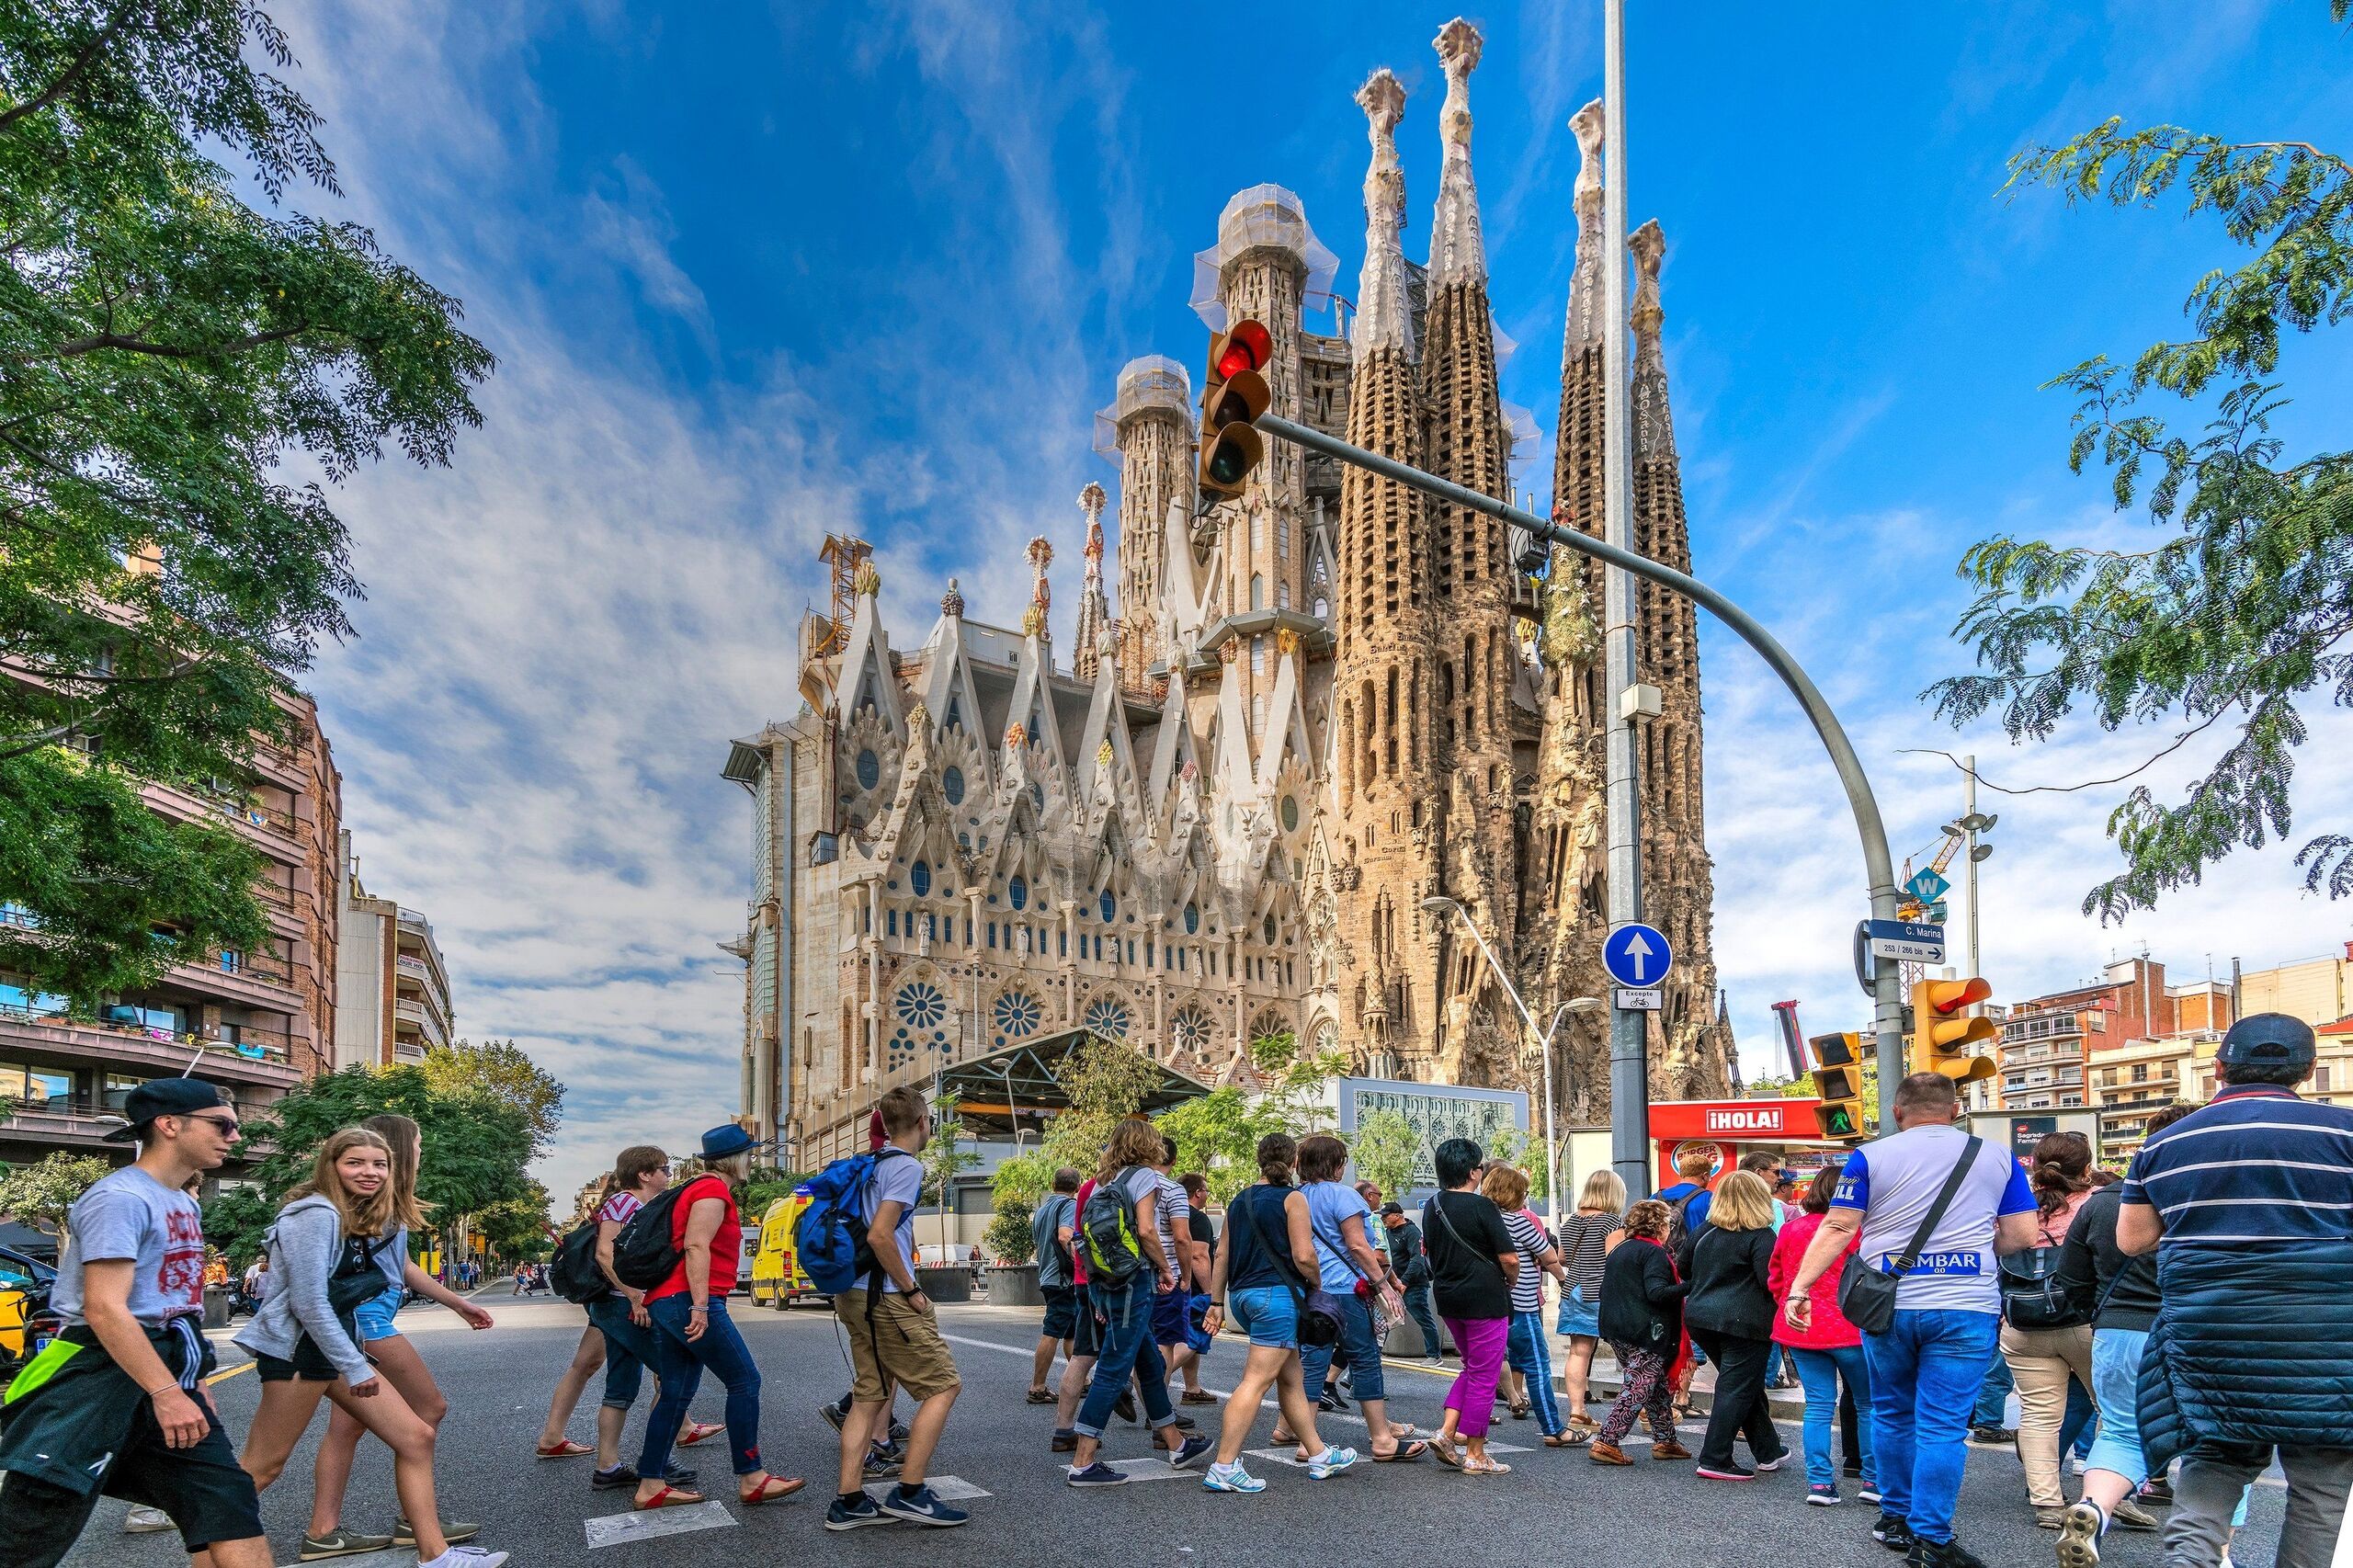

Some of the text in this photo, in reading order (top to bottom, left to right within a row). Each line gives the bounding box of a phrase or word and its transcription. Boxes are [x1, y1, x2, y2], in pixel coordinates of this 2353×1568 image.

[1916, 878, 1938, 894] W
[1905, 926, 1941, 938] C. Marina
[1884, 944, 1896, 952] 253
[1915, 948, 1924, 956] bis
[1710, 1111, 1779, 1130] ¡HOLA!
[1912, 1254, 1978, 1268] MBAR
